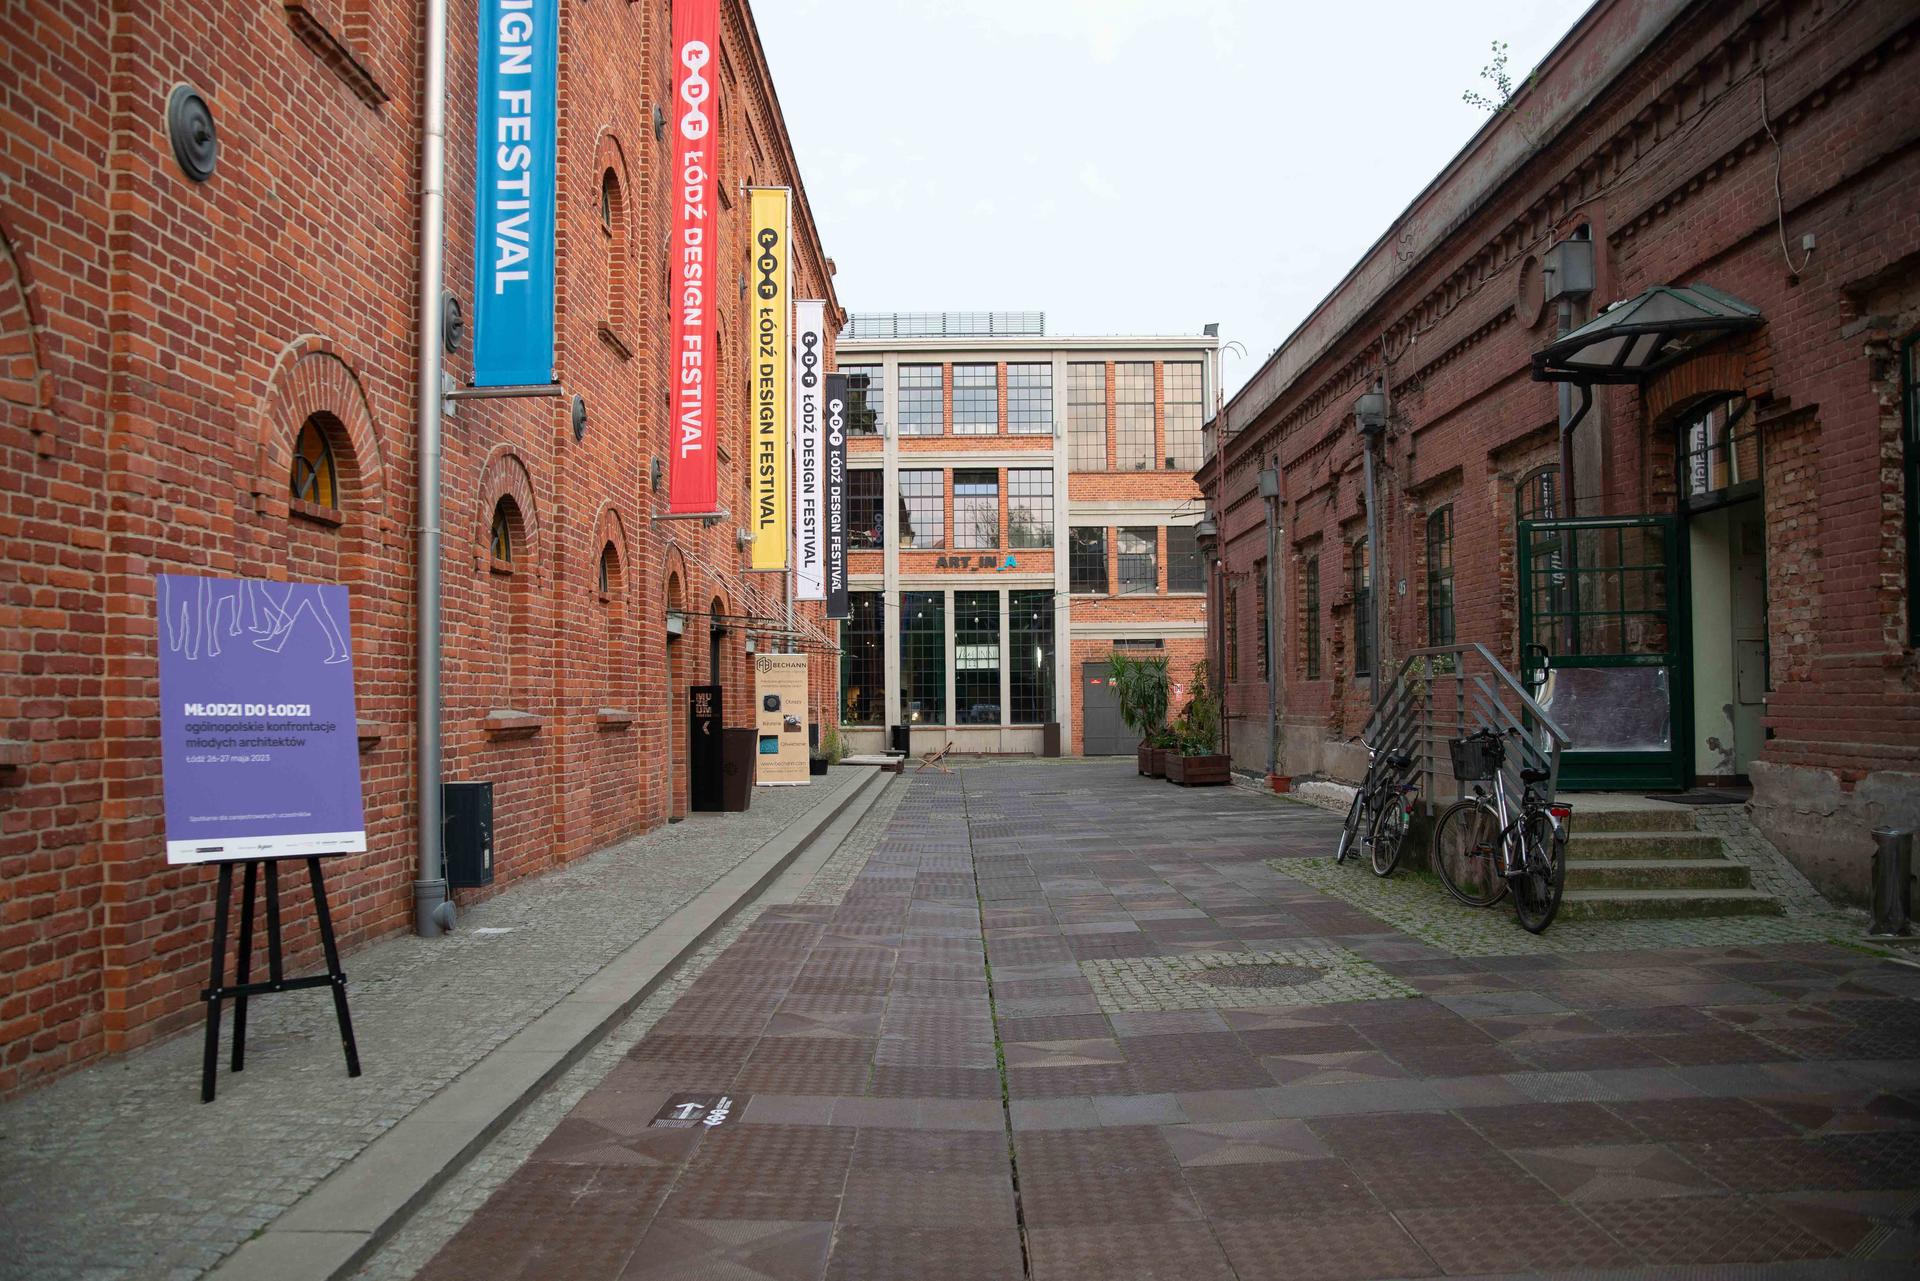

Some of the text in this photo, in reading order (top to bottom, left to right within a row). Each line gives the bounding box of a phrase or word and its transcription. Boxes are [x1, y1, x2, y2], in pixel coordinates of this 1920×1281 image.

[495, 90, 532, 295] FESTIVAL
[684, 150, 708, 221] ŁÓDŹ
[683, 227, 703, 326] DESIGN
[759, 308, 778, 358] ŁÓDŹ
[681, 335, 703, 460] FESTIVAL
[759, 364, 775, 435] DESIGN
[803, 393, 818, 434] ŁÓDŹ
[759, 441, 775, 530] FESTIVAL
[803, 438, 815, 494] DESIGN
[830, 450, 843, 483] ŁÓDŹ
[803, 499, 816, 568] FESTIVAL
[830, 486, 841, 533] DESIGN
[830, 536, 842, 593] FESTIVAL
[184, 703, 311, 717] MŁODZI DO ŁODZI
[185, 720, 336, 734] ogólnopolskie konfrontacje
[185, 736, 306, 750] młodych architektów
[231, 754, 250, 764] maja
[250, 754, 271, 762] 2023
